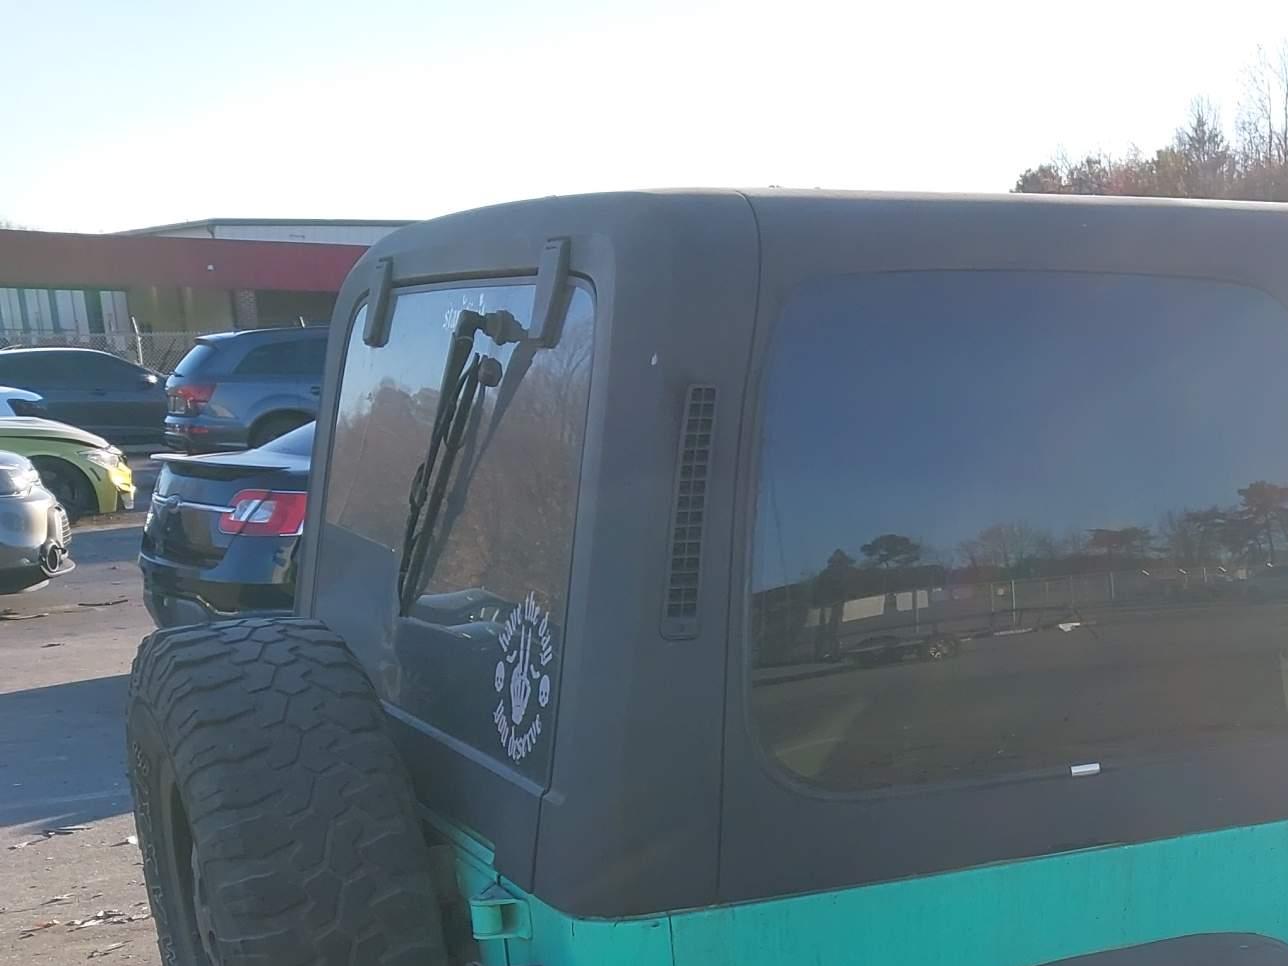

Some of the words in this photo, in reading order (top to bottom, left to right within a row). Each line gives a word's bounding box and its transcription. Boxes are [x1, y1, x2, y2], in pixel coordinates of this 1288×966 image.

[498, 603, 521, 652] have
[525, 591, 540, 626] the
[539, 611, 552, 666] day
[493, 699, 509, 747] you
[508, 713, 541, 760] deserve
